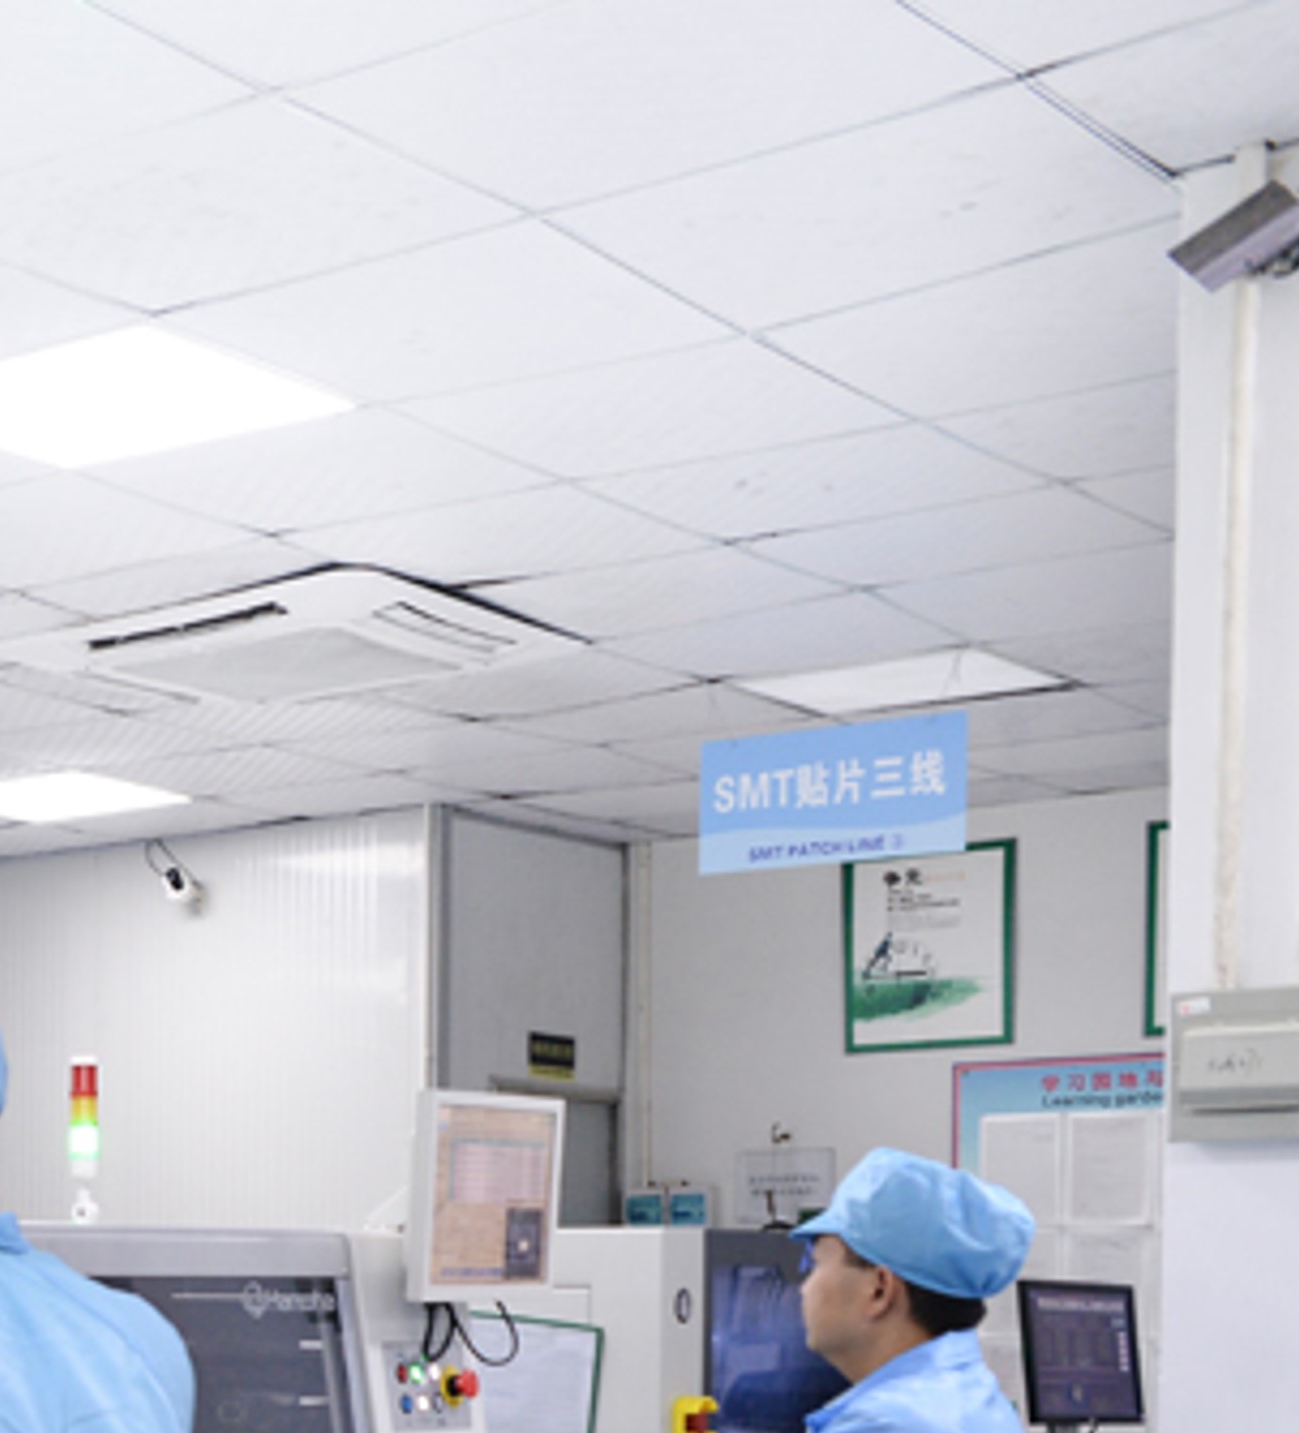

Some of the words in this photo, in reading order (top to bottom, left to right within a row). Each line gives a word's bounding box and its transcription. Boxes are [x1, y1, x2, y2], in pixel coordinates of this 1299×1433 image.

[713, 748, 947, 814] SMT贴片三线
[1041, 1094, 1112, 1109] Learning
[1114, 1090, 1163, 1108] garde
